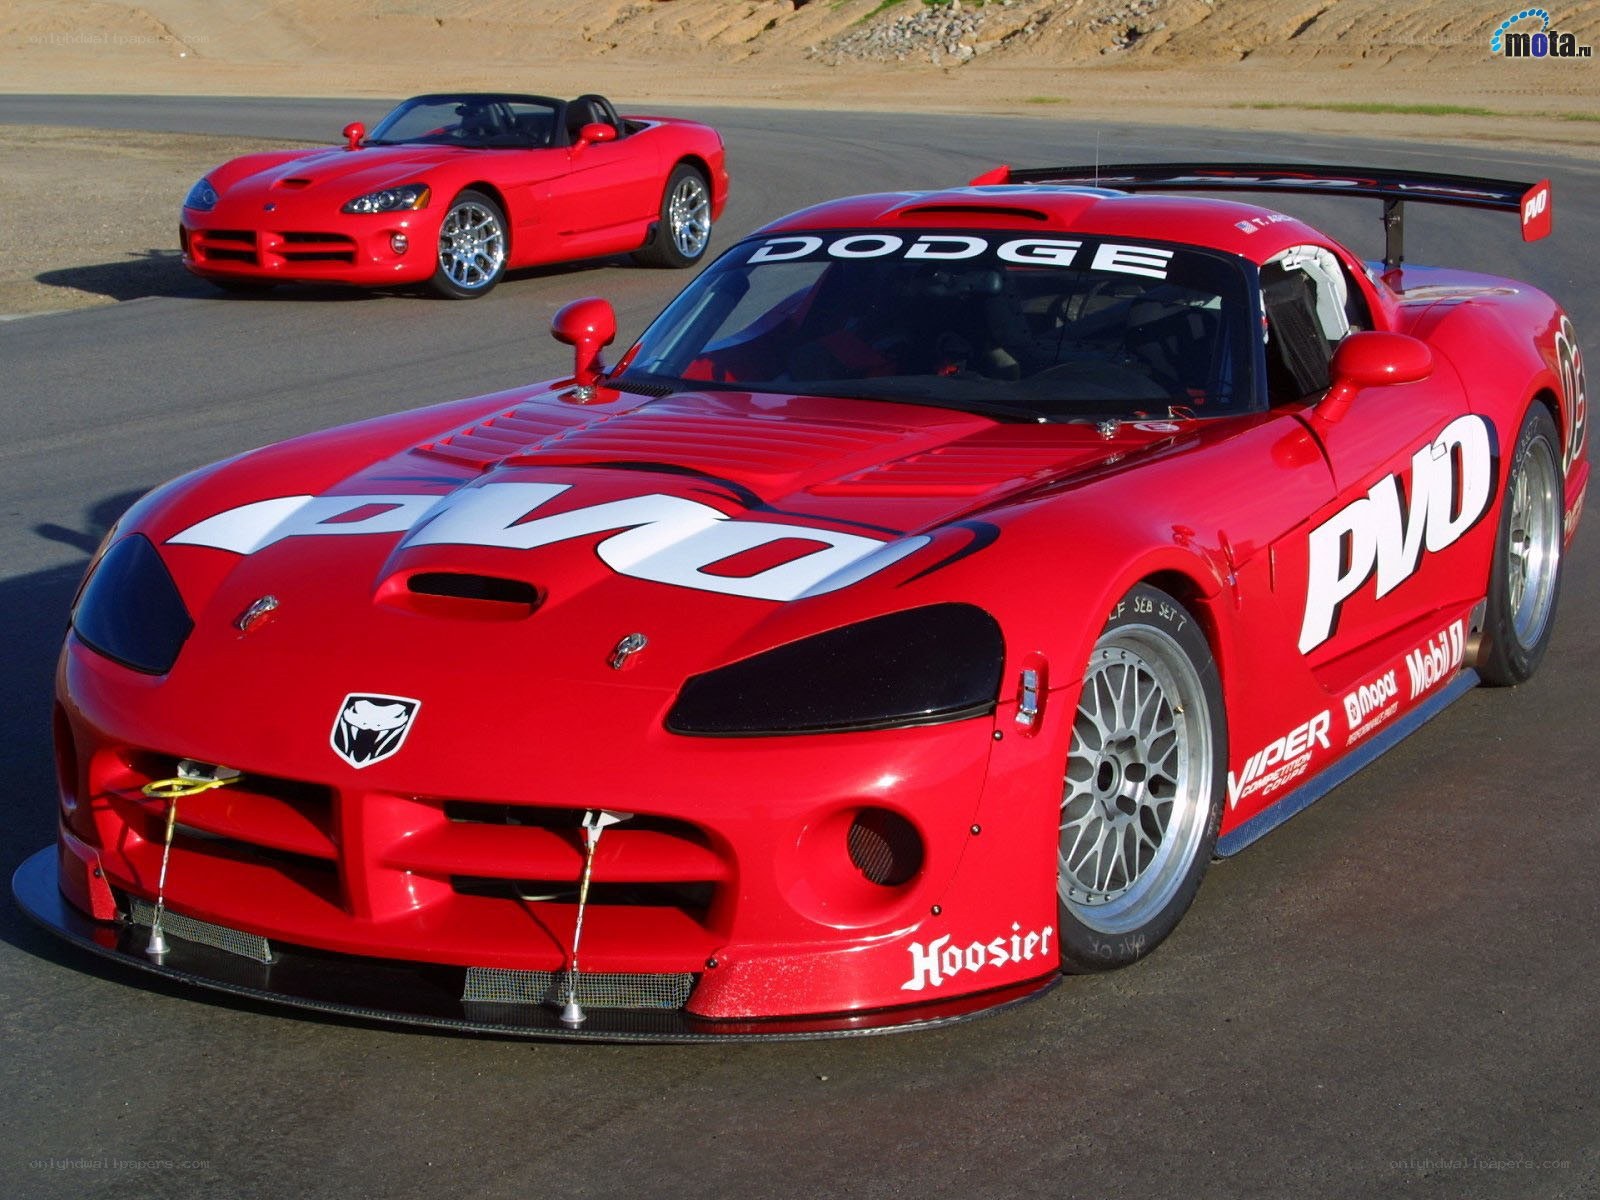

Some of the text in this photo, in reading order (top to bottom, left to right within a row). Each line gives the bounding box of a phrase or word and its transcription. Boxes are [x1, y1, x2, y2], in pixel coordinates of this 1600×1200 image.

[1523, 188, 1547, 225] PVO
[747, 235, 1174, 280] DODGE
[166, 482, 931, 602] PVO
[1298, 413, 1497, 656] PVO
[1134, 596, 1153, 614] SEB
[1159, 601, 1178, 622] SET
[1405, 630, 1450, 700] Mobil
[1227, 709, 1331, 812] VIPER
[1262, 763, 1308, 796] COUPE
[900, 921, 1053, 991] Hoosier
